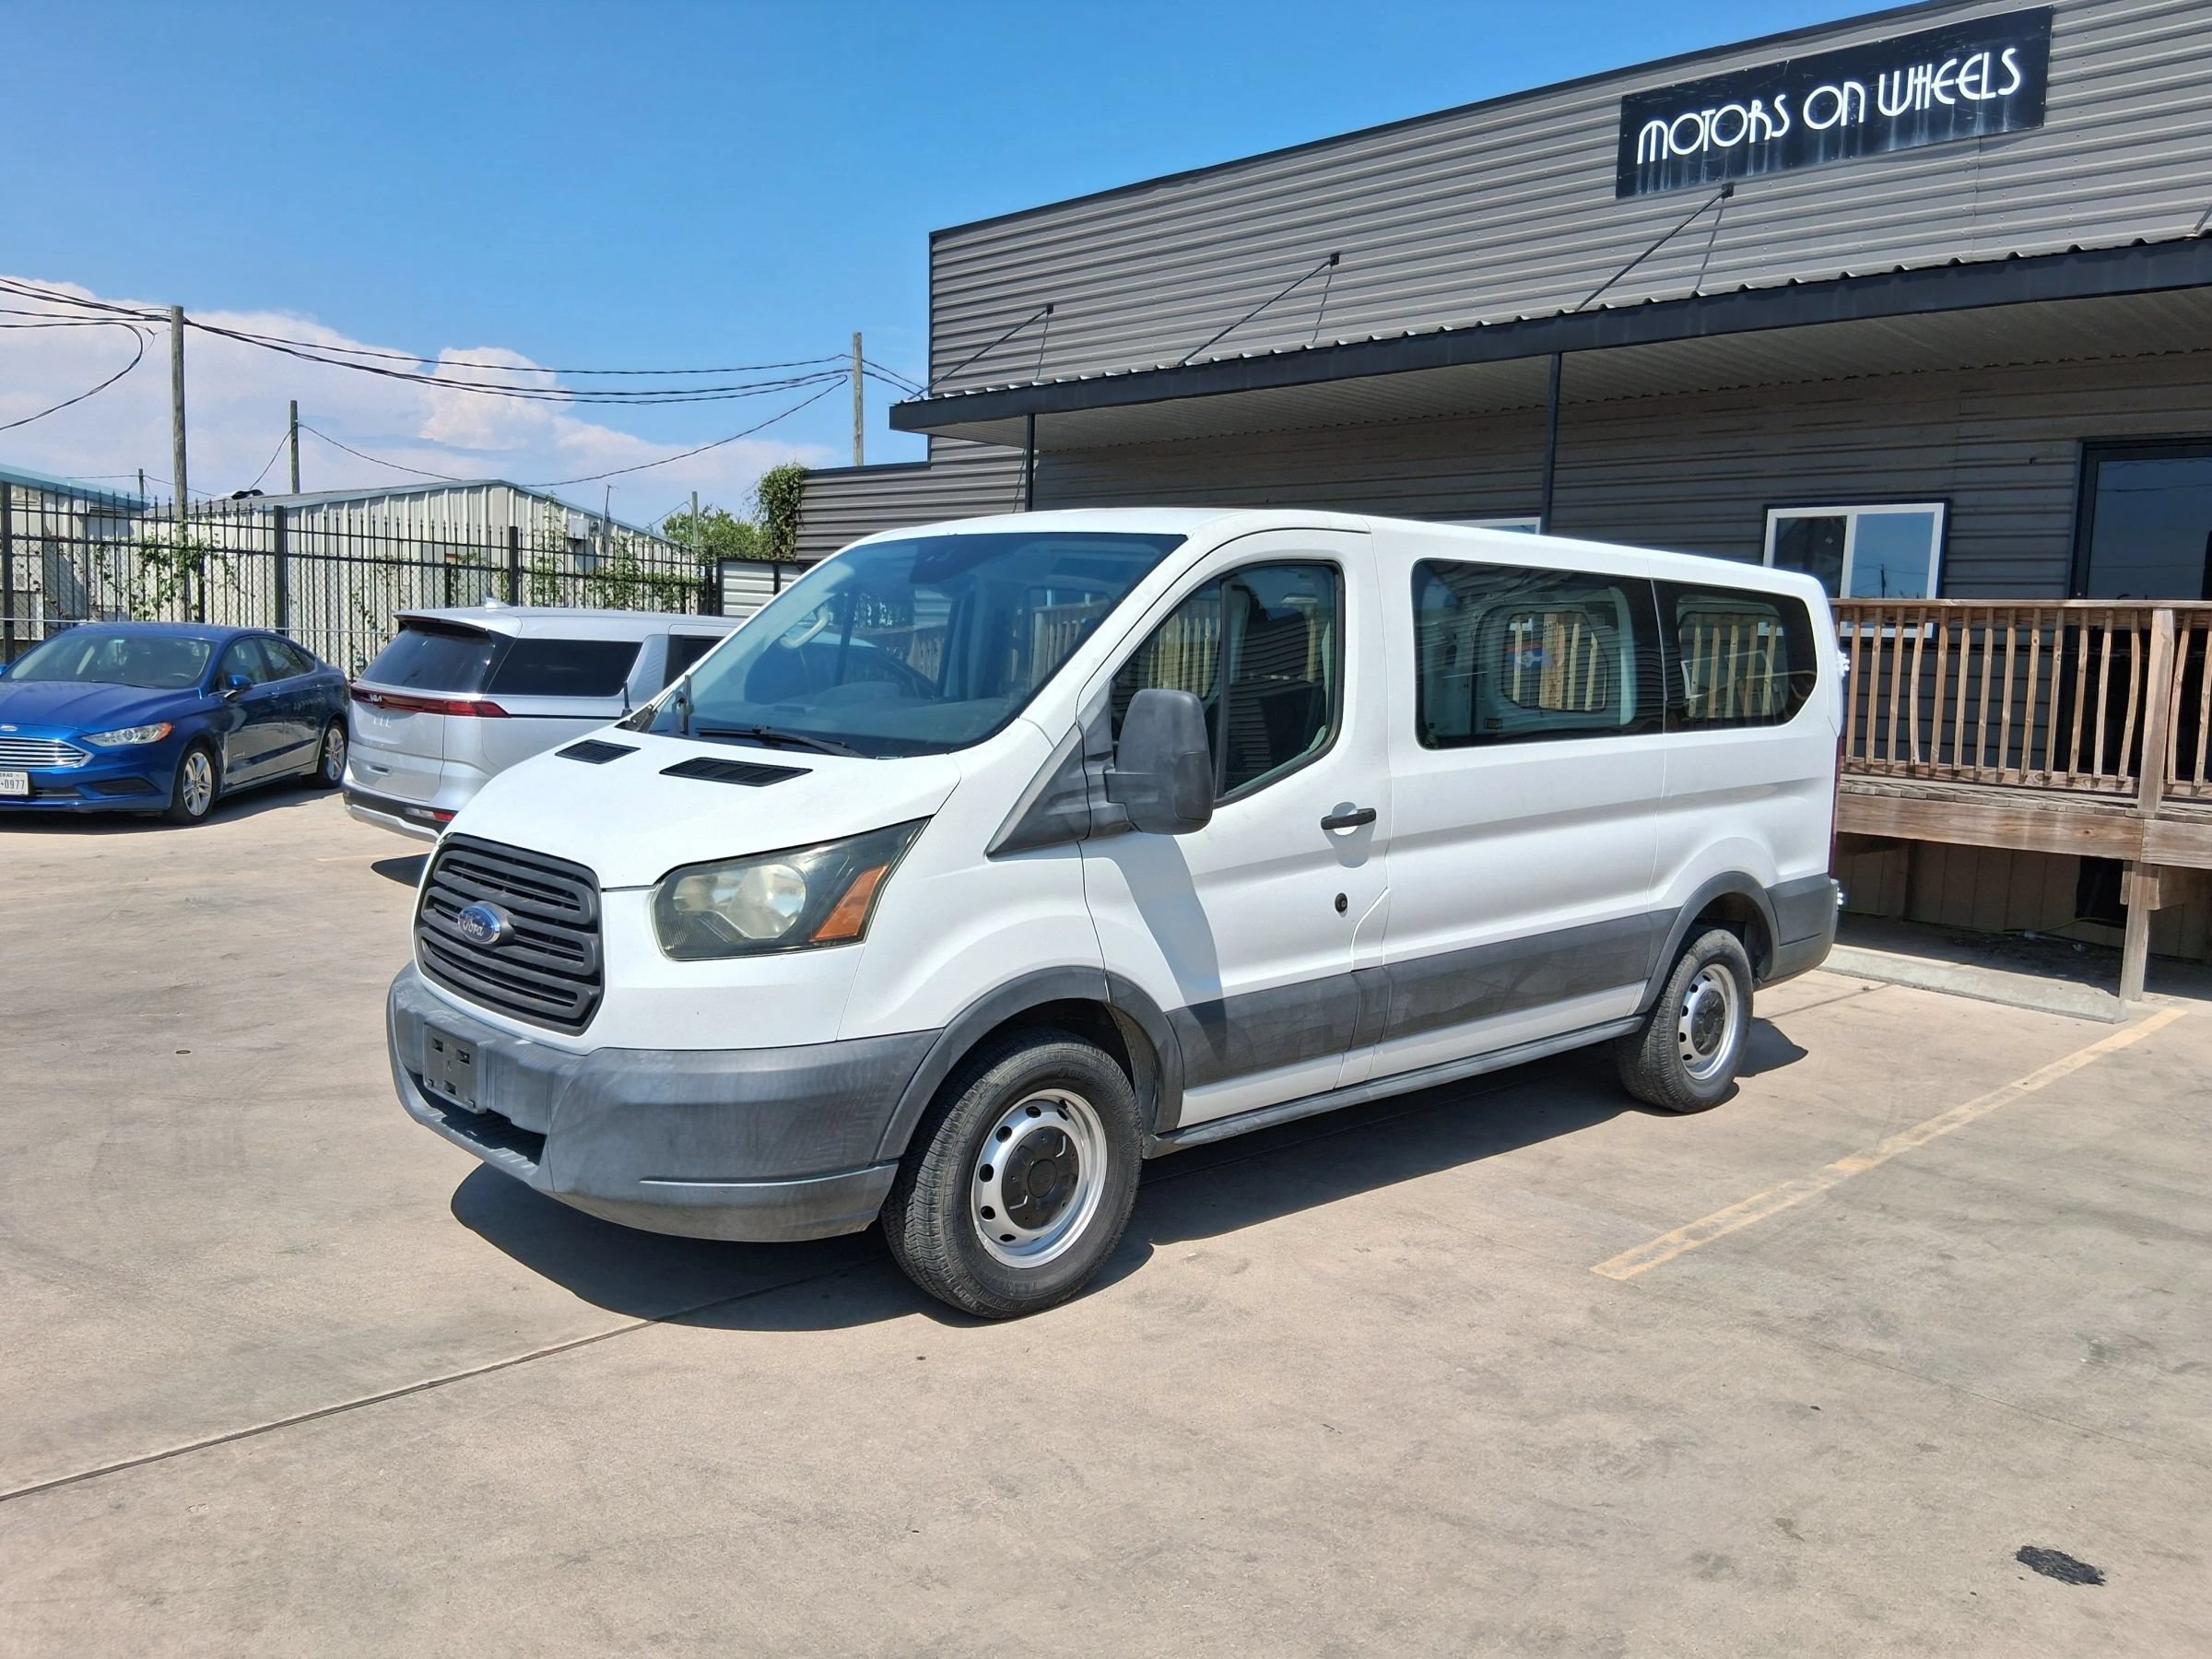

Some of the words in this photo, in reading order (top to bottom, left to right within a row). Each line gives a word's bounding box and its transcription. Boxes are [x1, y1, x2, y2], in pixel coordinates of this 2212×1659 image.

[1637, 94, 1791, 165] MOTORS
[1803, 81, 1865, 130] ON
[1877, 48, 2021, 117] WHEELS
[462, 912, 485, 936] Ford
